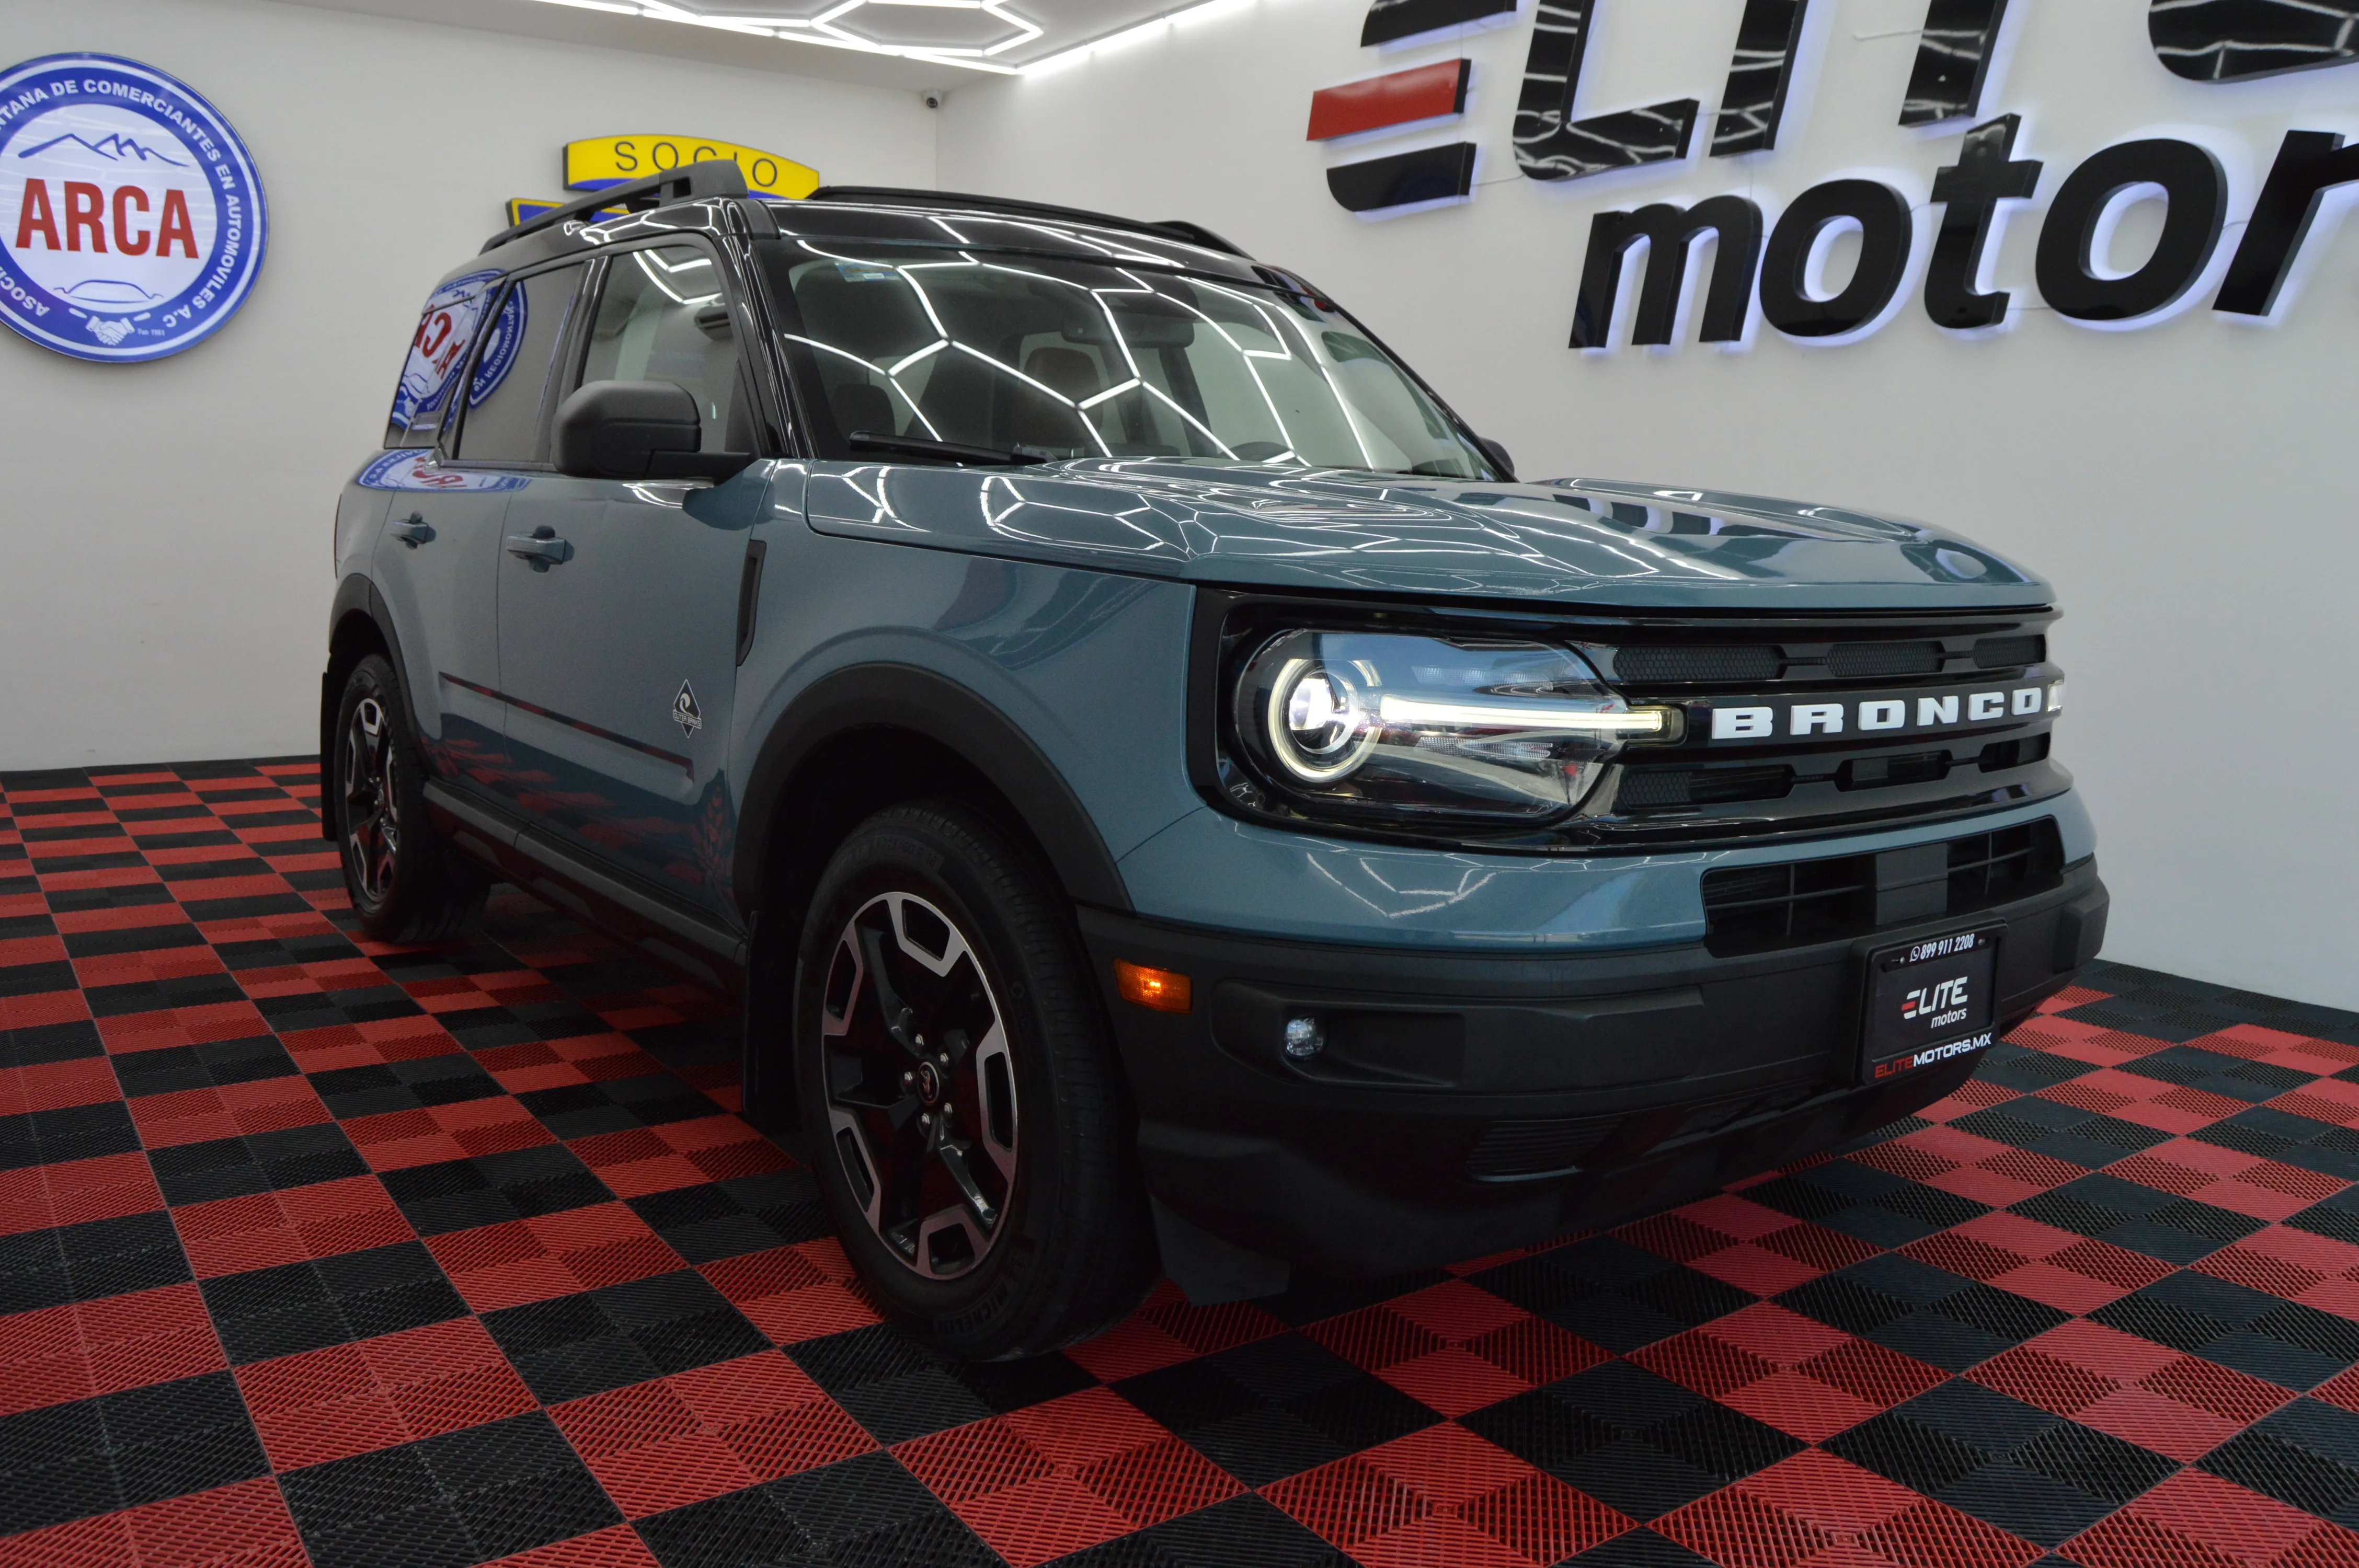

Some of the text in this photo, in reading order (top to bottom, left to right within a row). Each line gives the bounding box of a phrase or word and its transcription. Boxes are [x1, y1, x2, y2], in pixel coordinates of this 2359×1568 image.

[50, 79, 78, 96] DE
[82, 78, 221, 162] COMERCIANTES
[214, 164, 236, 190] EN
[15, 178, 199, 259] ARCA
[192, 194, 242, 309] AUTOMOVILES
[674, 712, 686, 722] OUTER
[1712, 687, 2042, 739] BRONCO
[1920, 933, 1975, 960] 899 911 2208
[1901, 976, 1968, 1019] ELITE
[1930, 1008, 1967, 1029] motors
[1875, 1032, 1992, 1079] ELITEMOTORS.MX
